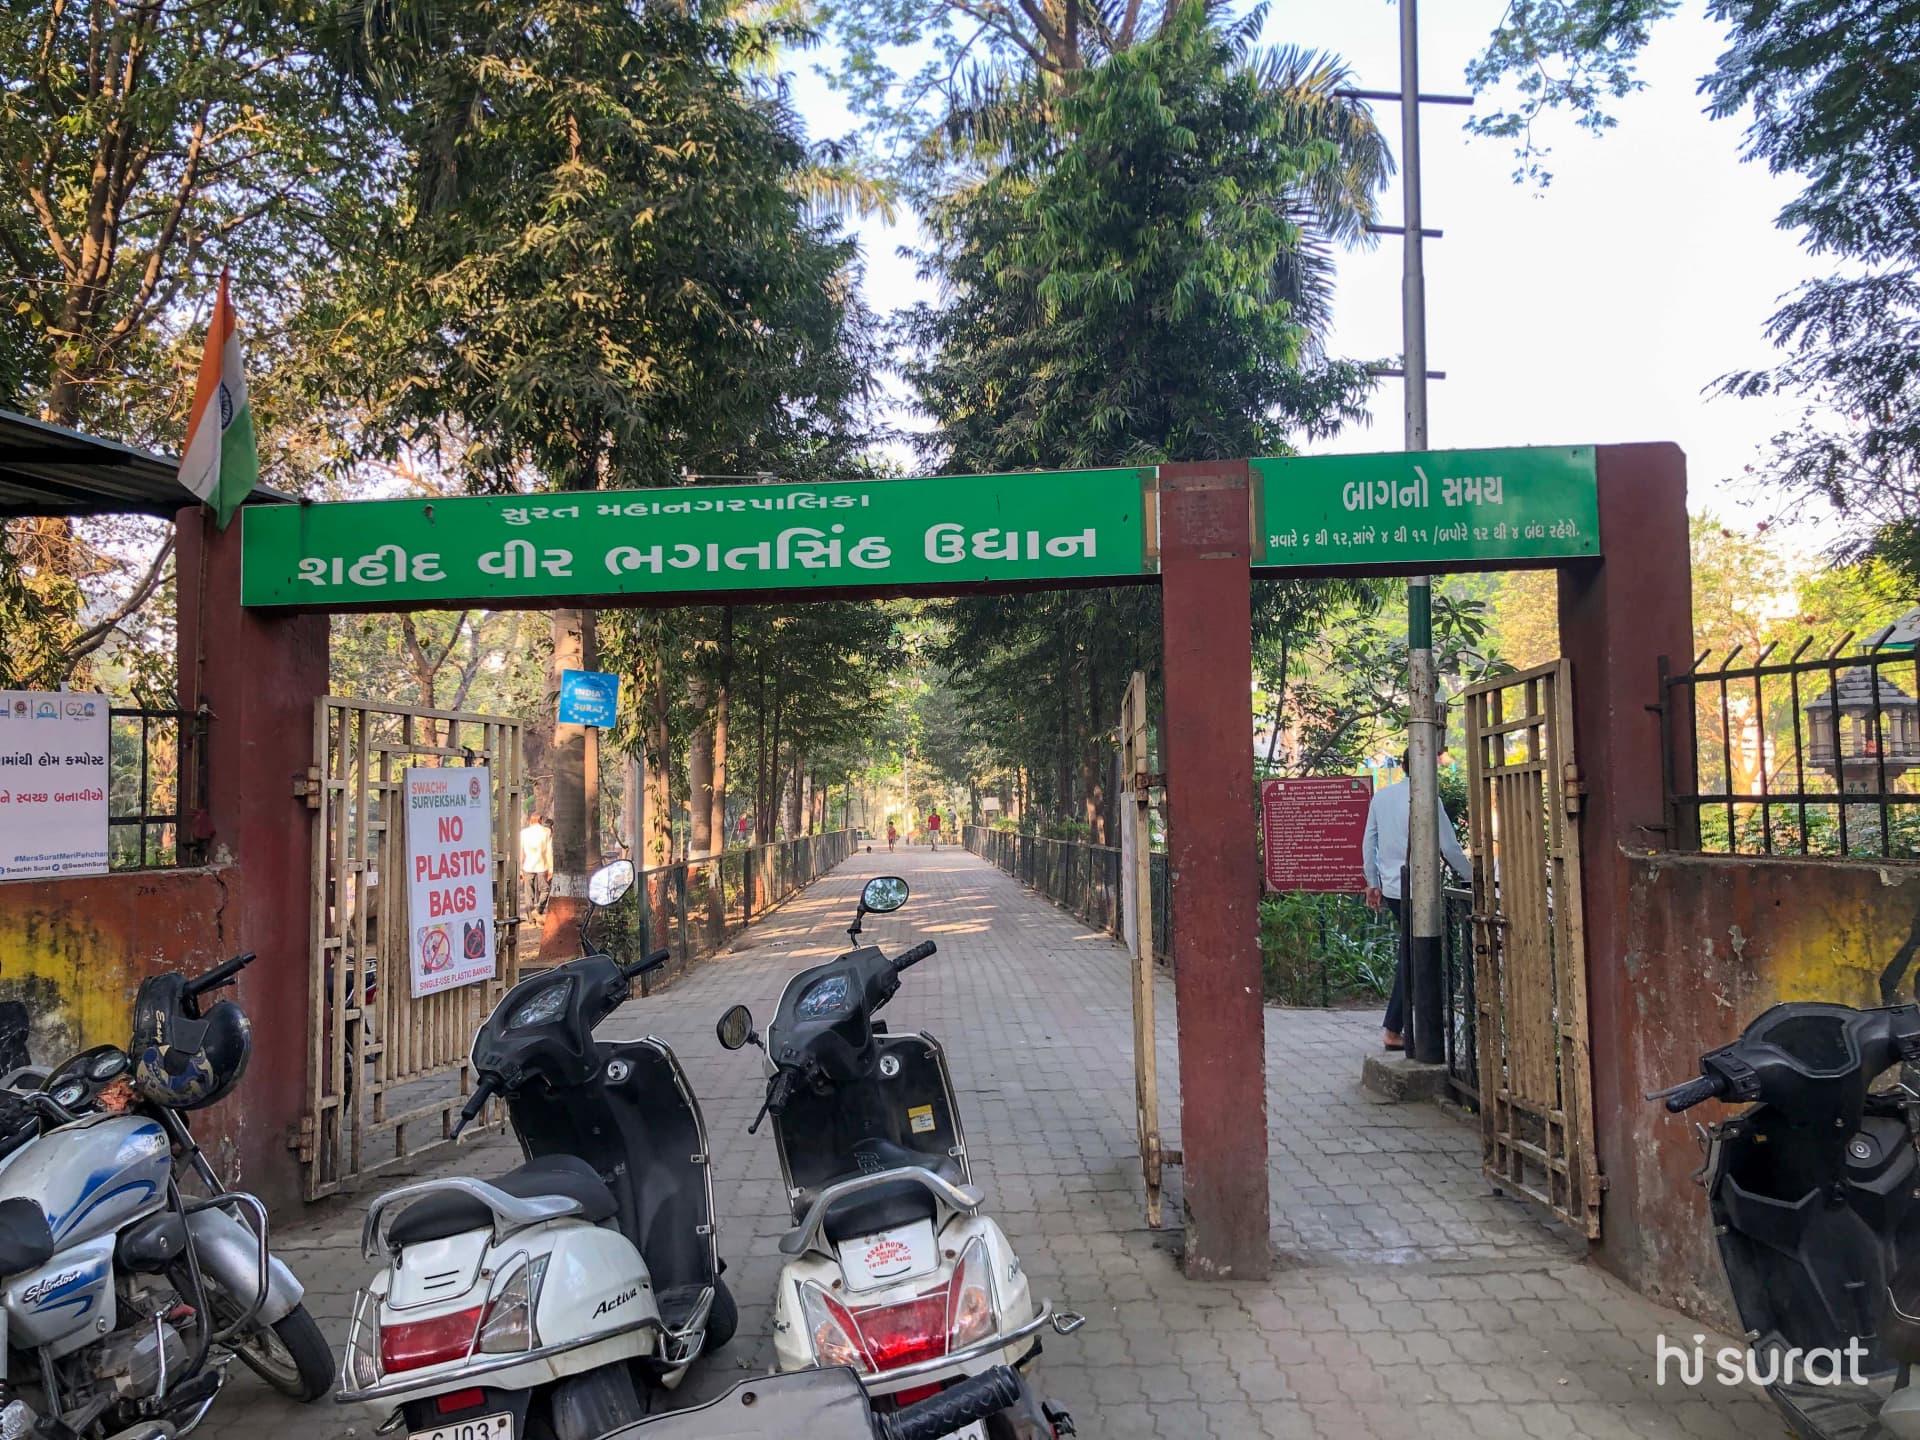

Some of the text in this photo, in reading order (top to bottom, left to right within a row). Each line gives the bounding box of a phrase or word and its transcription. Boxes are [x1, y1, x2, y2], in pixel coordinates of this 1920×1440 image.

[1342, 465, 1503, 511] બાગનો સમય
[501, 492, 870, 526] સુરત મહાનગરપાલિકા
[1270, 529, 1298, 547] સવારે
[1315, 528, 1328, 545] થી
[1381, 530, 1389, 543] ૪
[1394, 525, 1407, 542] થી
[1412, 530, 1428, 542] ૧૧
[1473, 527, 1489, 541] ૧૨
[1494, 522, 1507, 540] થી
[1511, 526, 1519, 539] ૪
[297, 544, 448, 587] શહીદ
[477, 539, 574, 579] વીર
[604, 523, 892, 576] ભગતસિંહ
[38, 751, 60, 767] હોમ
[15, 792, 49, 803] સ્વચ્છ
[54, 787, 104, 802] બનાવીએ
[411, 781, 448, 795] SWACHH
[411, 793, 467, 809] SURVEKSHAN
[438, 815, 464, 843] NO
[415, 849, 486, 882] PLASTIC
[428, 885, 477, 918] BAGS
[419, 975, 450, 990] SINGLE-USE
[451, 969, 472, 984] PLASTIC
[592, 1287, 637, 1320] Activa
